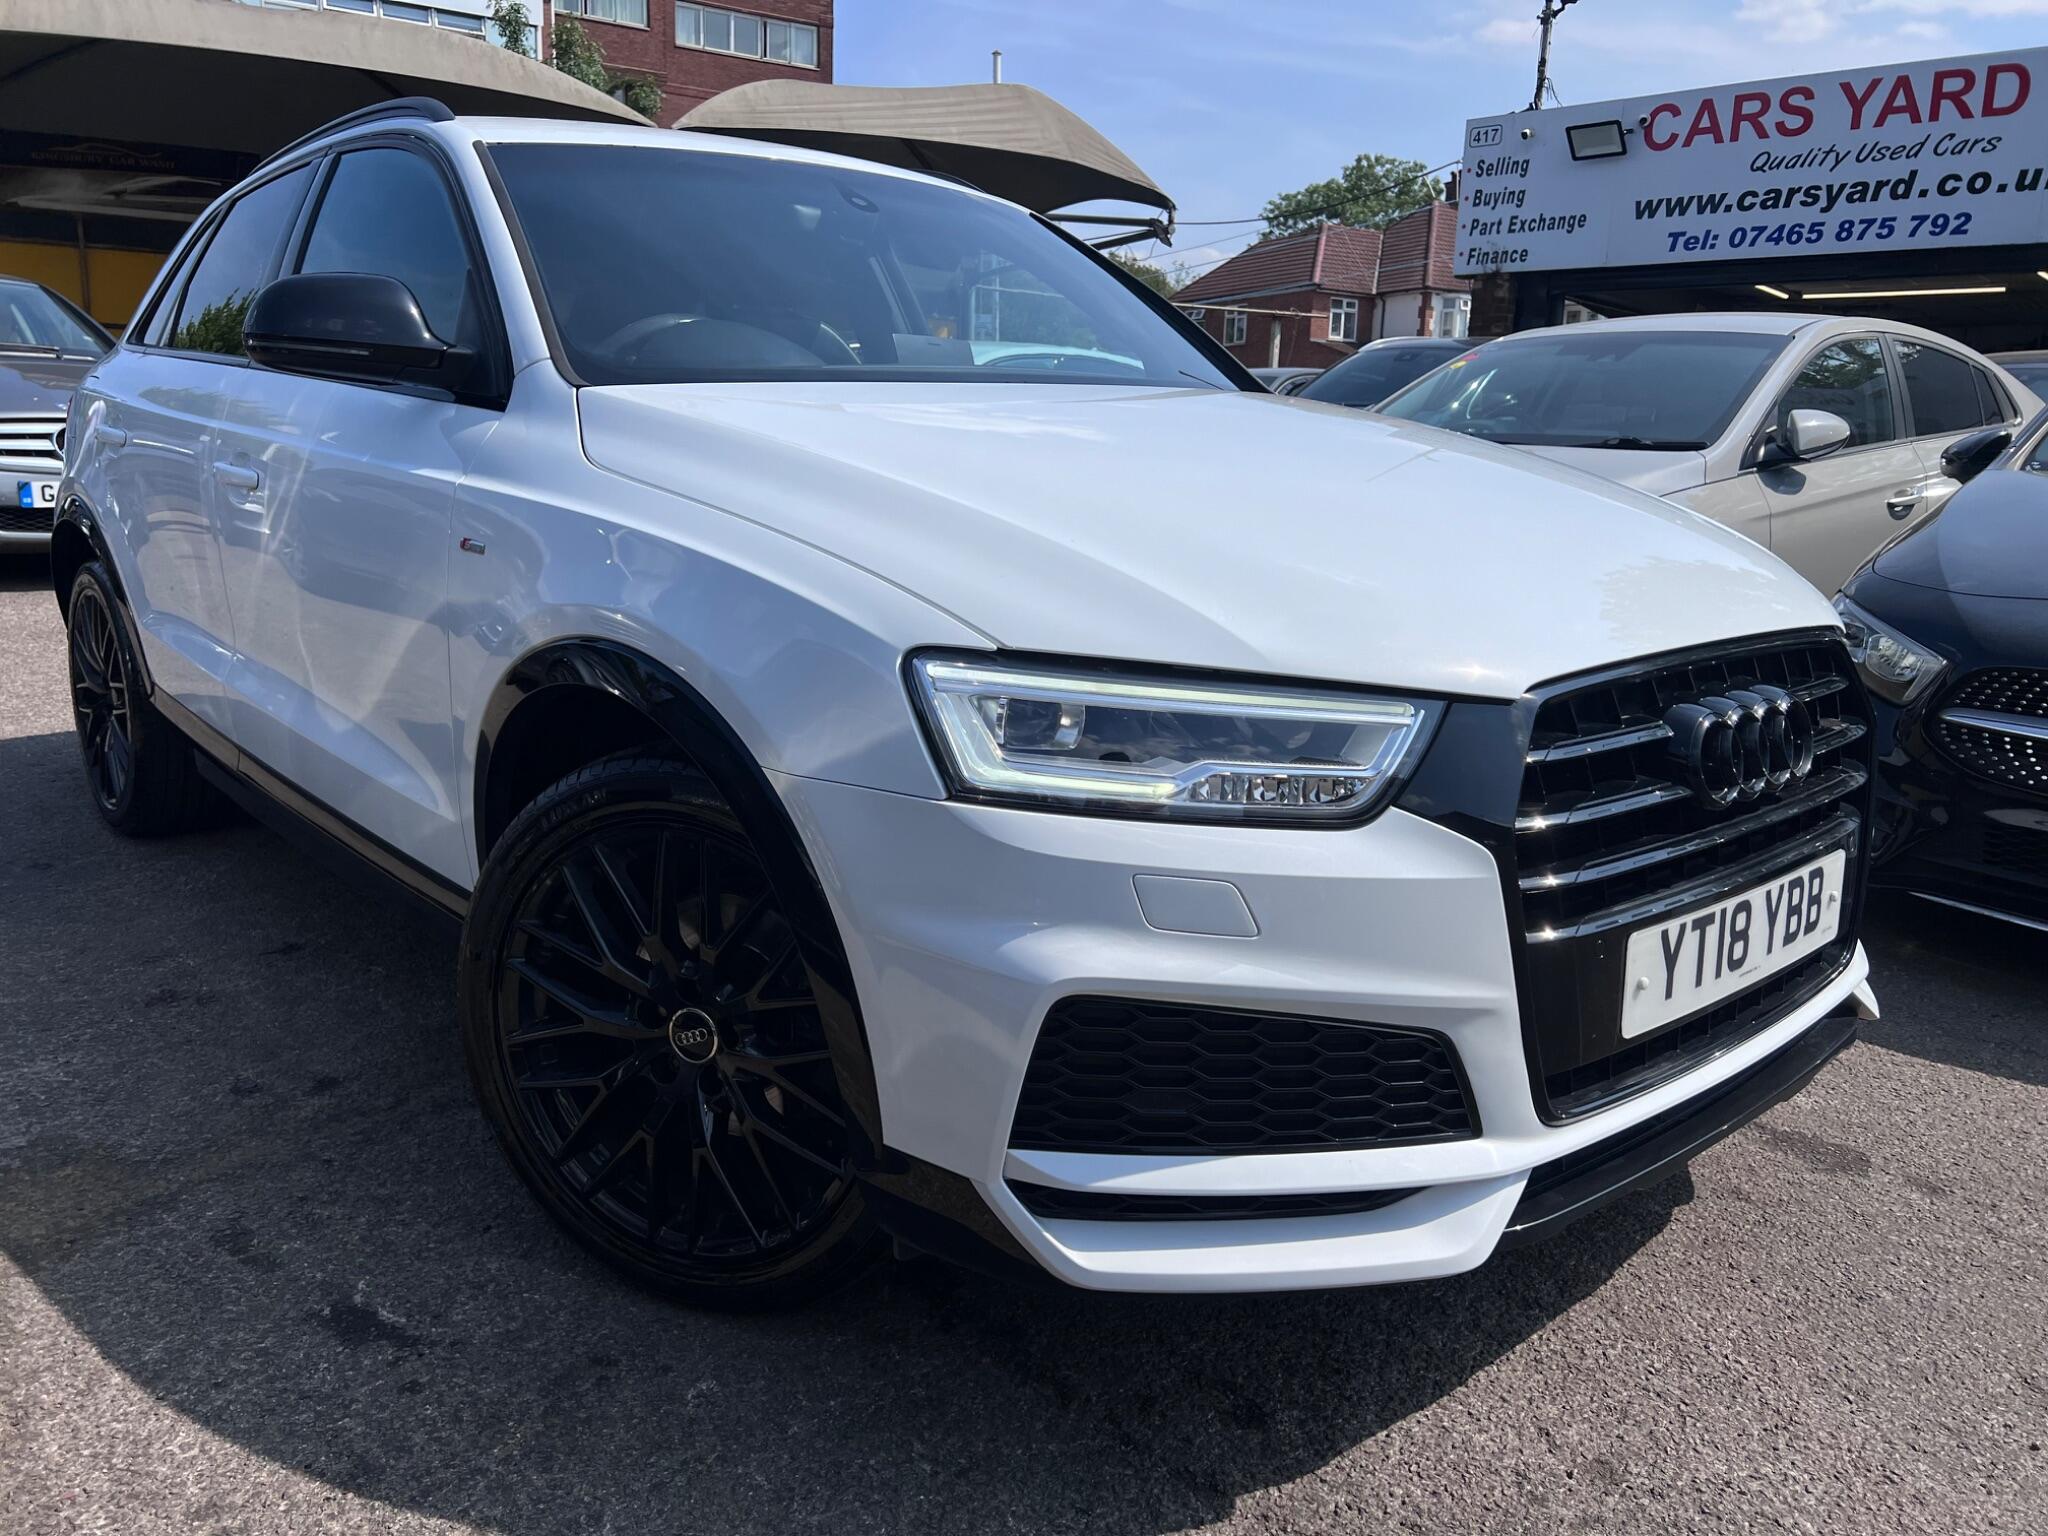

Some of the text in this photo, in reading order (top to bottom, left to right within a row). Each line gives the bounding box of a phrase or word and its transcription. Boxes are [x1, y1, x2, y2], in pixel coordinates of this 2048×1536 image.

[1643, 63, 2032, 152] CARS YARD
[1472, 128, 1500, 144] 417
[1475, 156, 1530, 178] Selling
[1750, 133, 2003, 174] Quality Used Cars
[1472, 186, 1527, 210] Buying
[1635, 167, 2048, 220] www.carsyard.co.u
[1469, 212, 1587, 237] Part Exchange
[1667, 212, 1973, 252] Tel: 07465 875 792
[1466, 248, 1529, 266] Finance
[1660, 866, 1825, 1001] YT18 YBB
